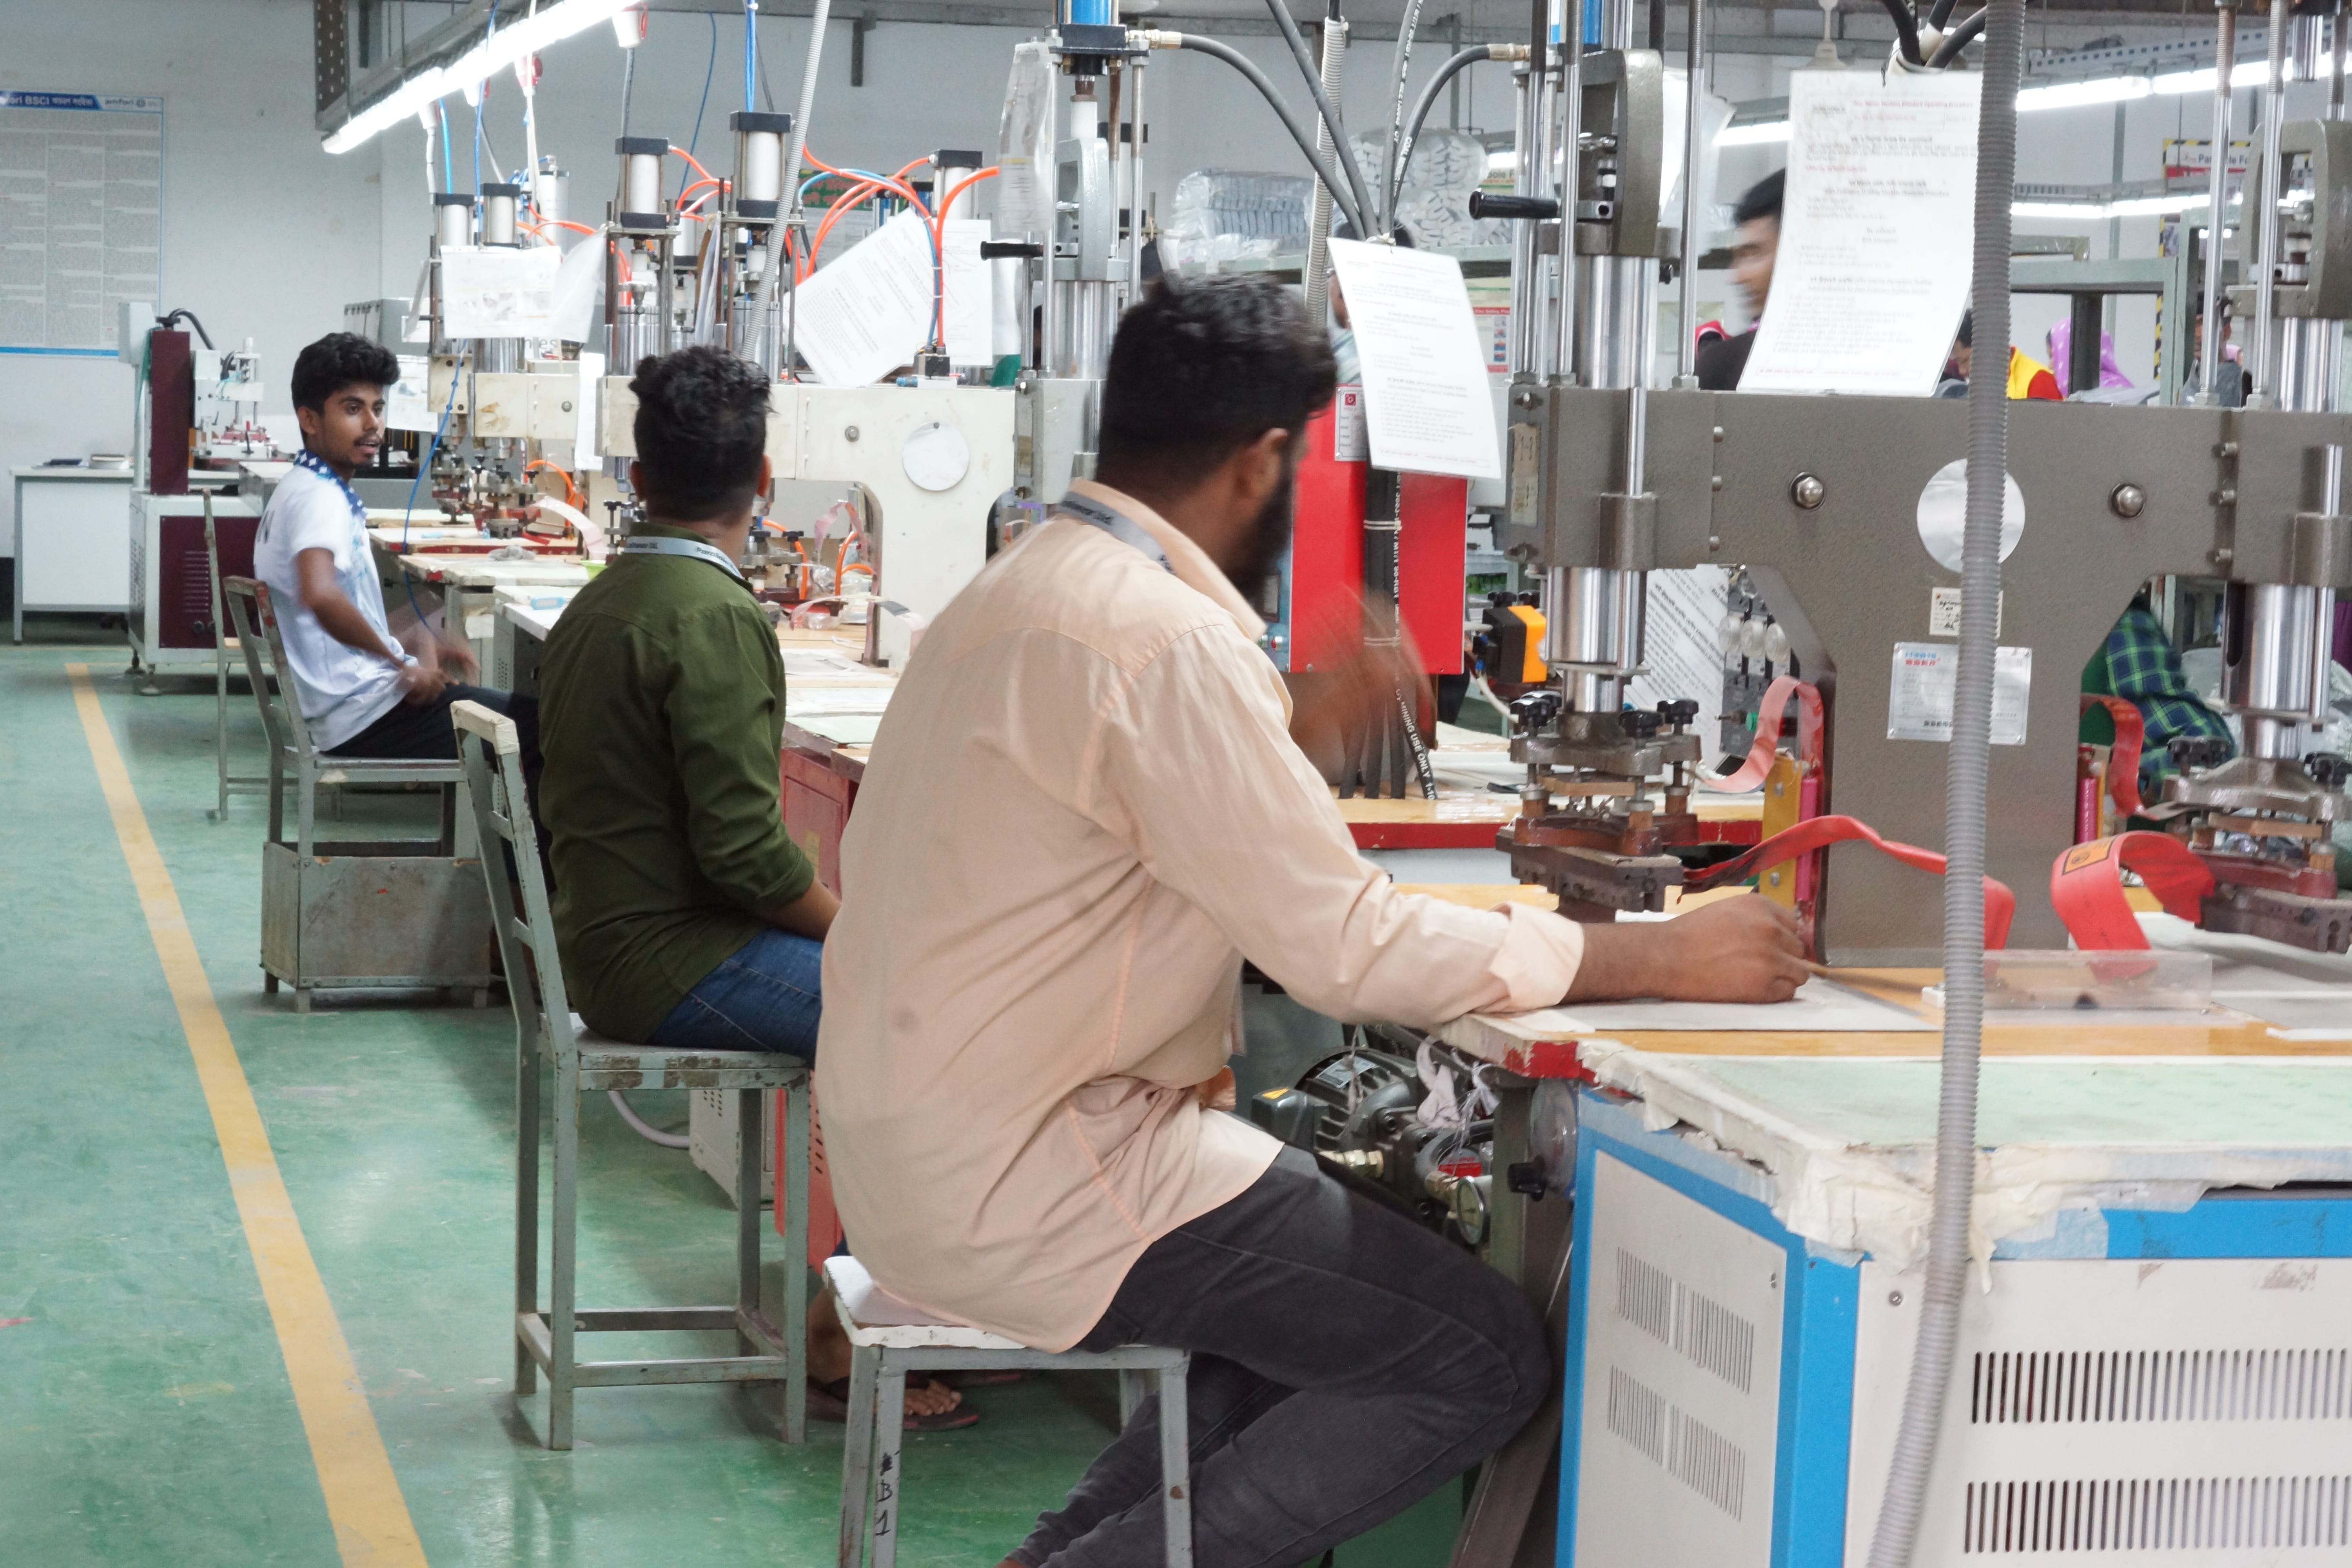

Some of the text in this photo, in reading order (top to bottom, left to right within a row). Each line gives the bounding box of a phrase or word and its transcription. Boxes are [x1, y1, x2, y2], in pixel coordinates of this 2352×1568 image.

[1401, 701, 1414, 733] MINING
[1410, 733, 1422, 752] USE
[1417, 753, 1430, 778] ONLY
